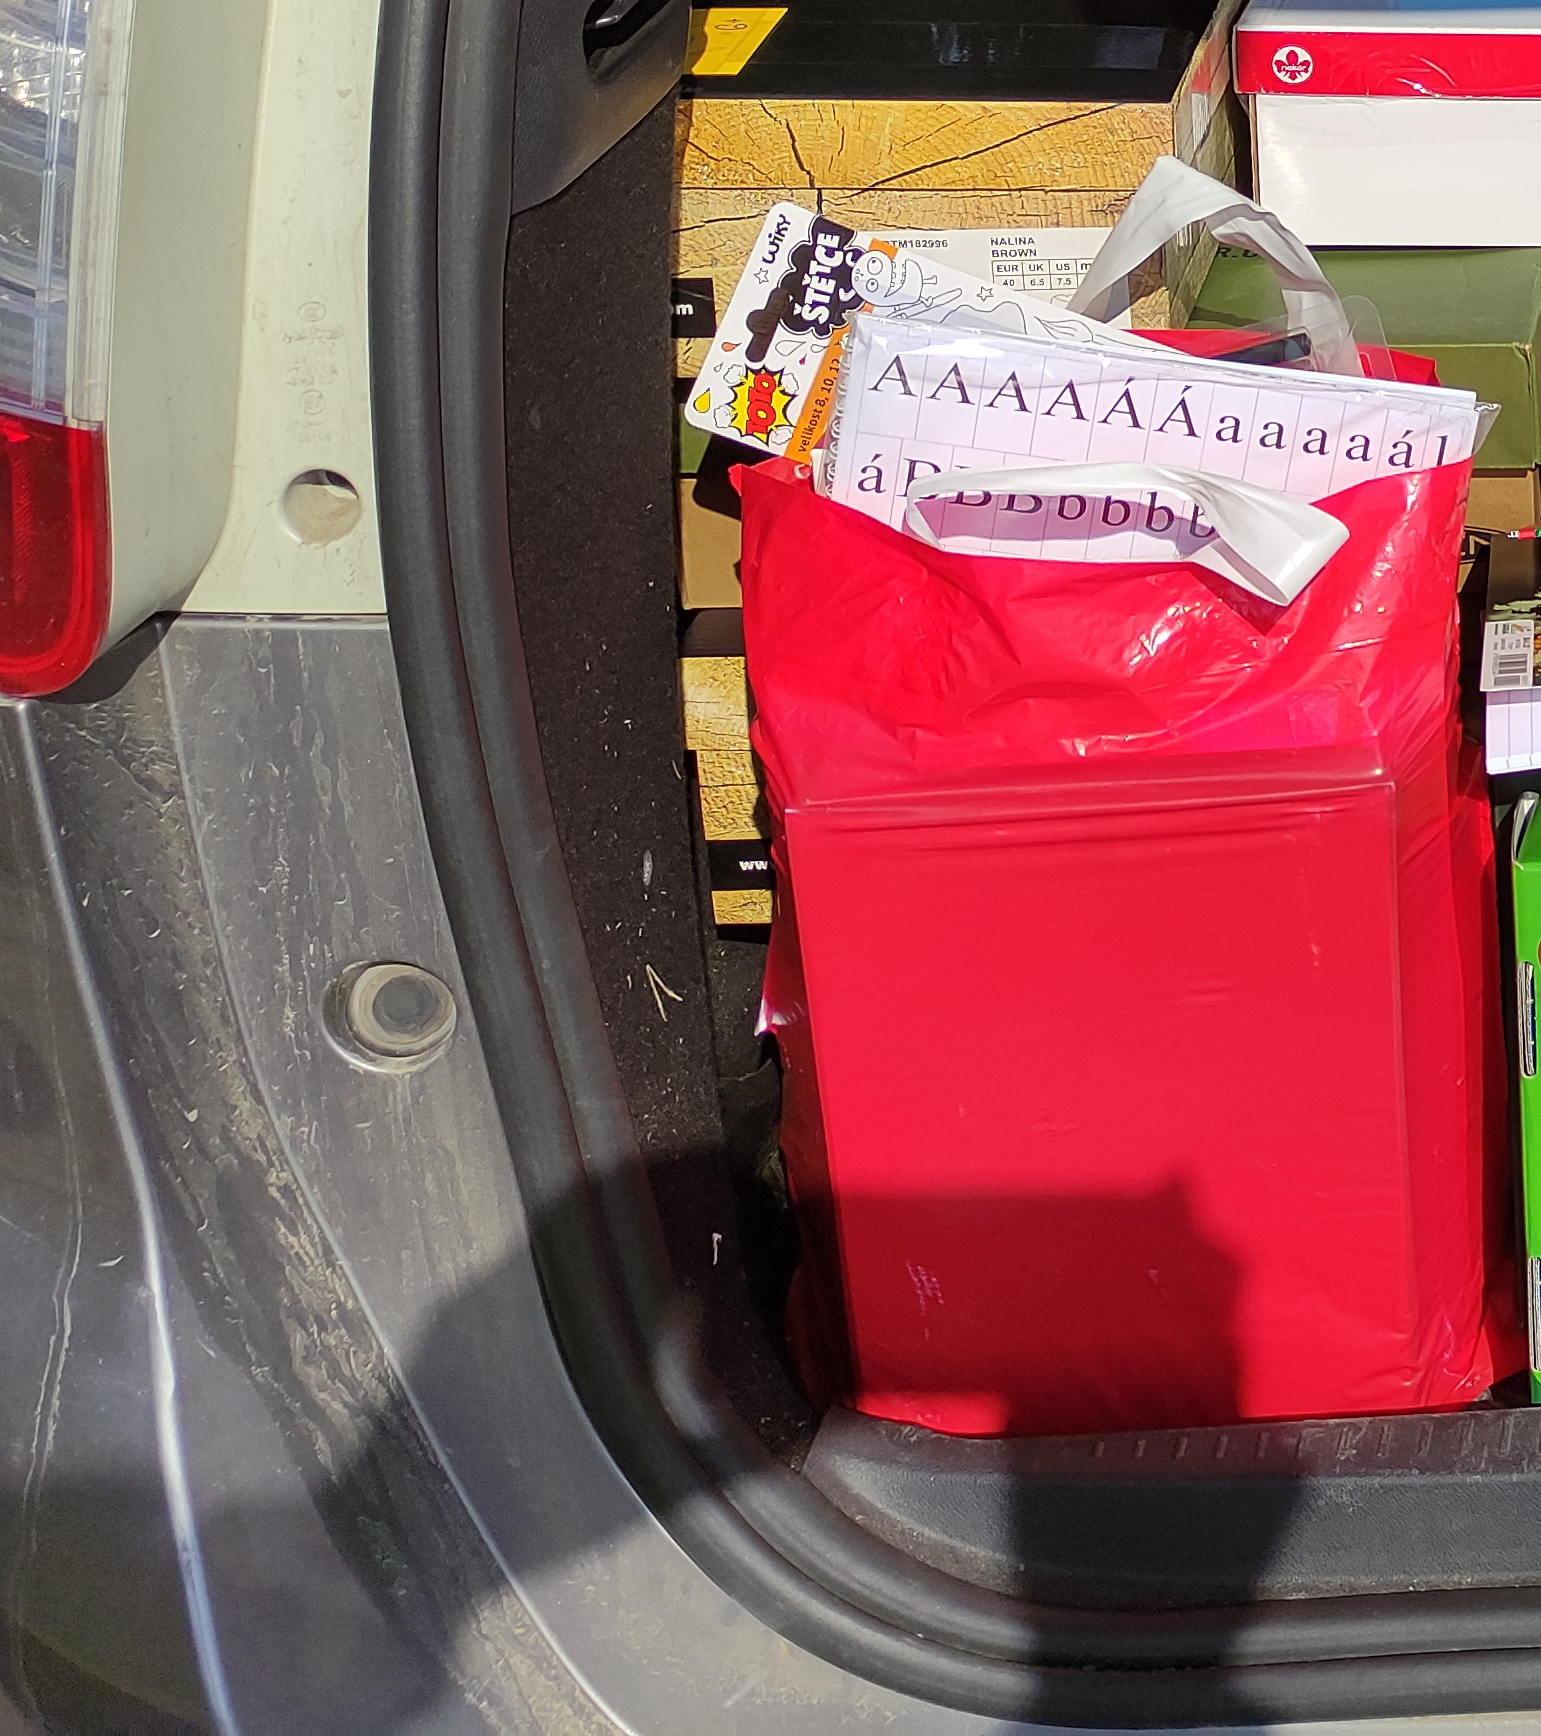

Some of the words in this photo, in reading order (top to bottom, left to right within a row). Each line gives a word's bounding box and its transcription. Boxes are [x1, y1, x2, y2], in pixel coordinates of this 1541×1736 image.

[990, 237, 1036, 246] NALINA
[991, 249, 1037, 258] BROWN
[793, 233, 841, 325] ŠTĚTCE
[996, 264, 1019, 273] EUR
[1029, 263, 1044, 272] UK
[1056, 263, 1071, 272] US
[1002, 279, 1015, 287] 40
[1056, 278, 1072, 286] 7.5
[869, 353, 914, 396] A
[926, 361, 976, 406] A
[984, 370, 1033, 413] A
[1041, 379, 1091, 422] A
[1098, 376, 1146, 430] Á
[1153, 384, 1202, 439] Á
[1214, 414, 1243, 444] a
[1259, 420, 1287, 450] a
[1302, 427, 1330, 457] a
[1345, 432, 1373, 463] a
[1387, 429, 1416, 469] á
[798, 406, 823, 452] velikost
[856, 451, 886, 494] á
